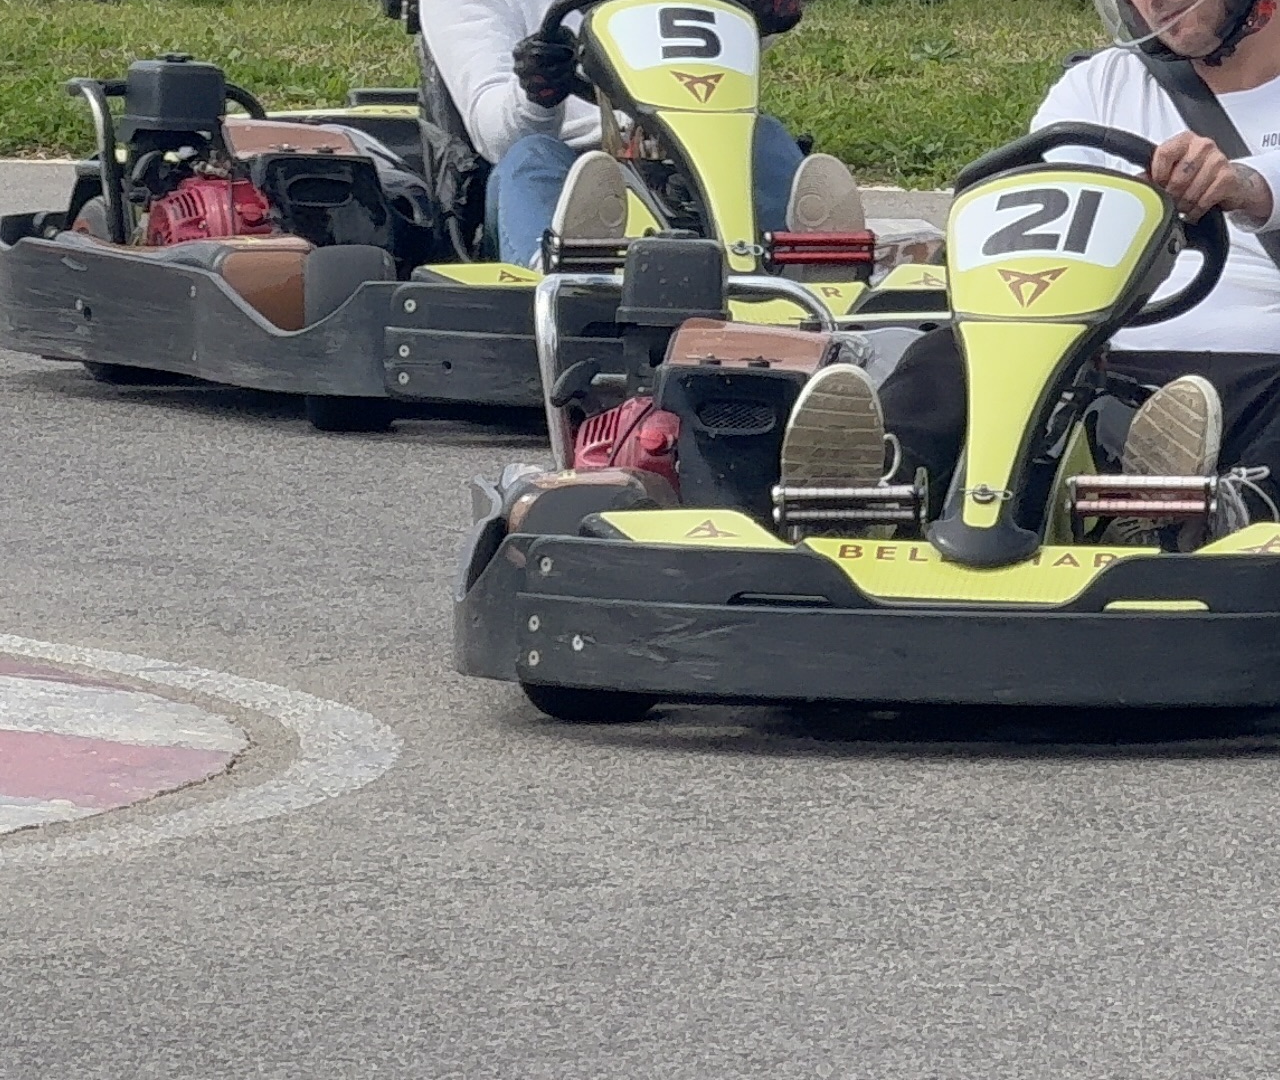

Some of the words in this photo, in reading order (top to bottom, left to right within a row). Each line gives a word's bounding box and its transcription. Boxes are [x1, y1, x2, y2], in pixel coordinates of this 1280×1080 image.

[659, 7, 721, 60] 5
[981, 188, 1104, 256] 21
[837, 543, 1118, 569] BELAR
